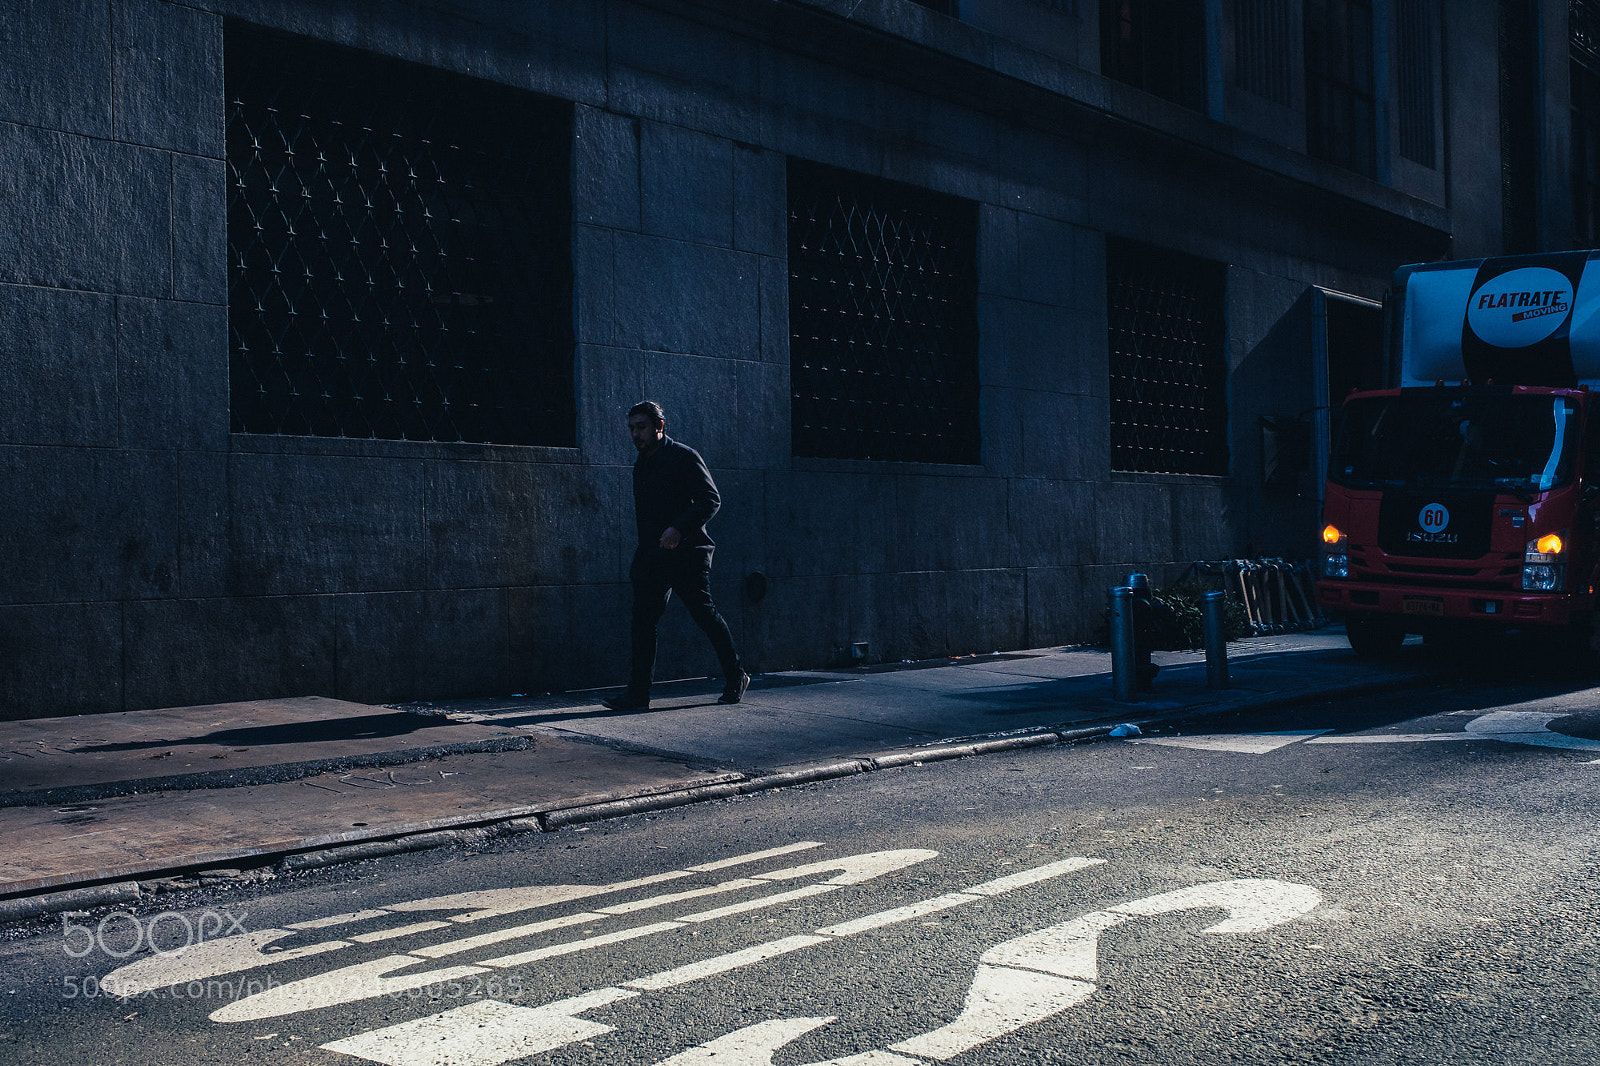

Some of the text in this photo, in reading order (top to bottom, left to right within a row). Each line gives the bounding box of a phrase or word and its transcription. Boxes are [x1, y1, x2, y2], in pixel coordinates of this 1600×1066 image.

[1478, 290, 1565, 310] FLATRATE
[1523, 304, 1565, 319] MOVING
[1424, 509, 1443, 526] 60
[1407, 532, 1458, 543] ISUZU
